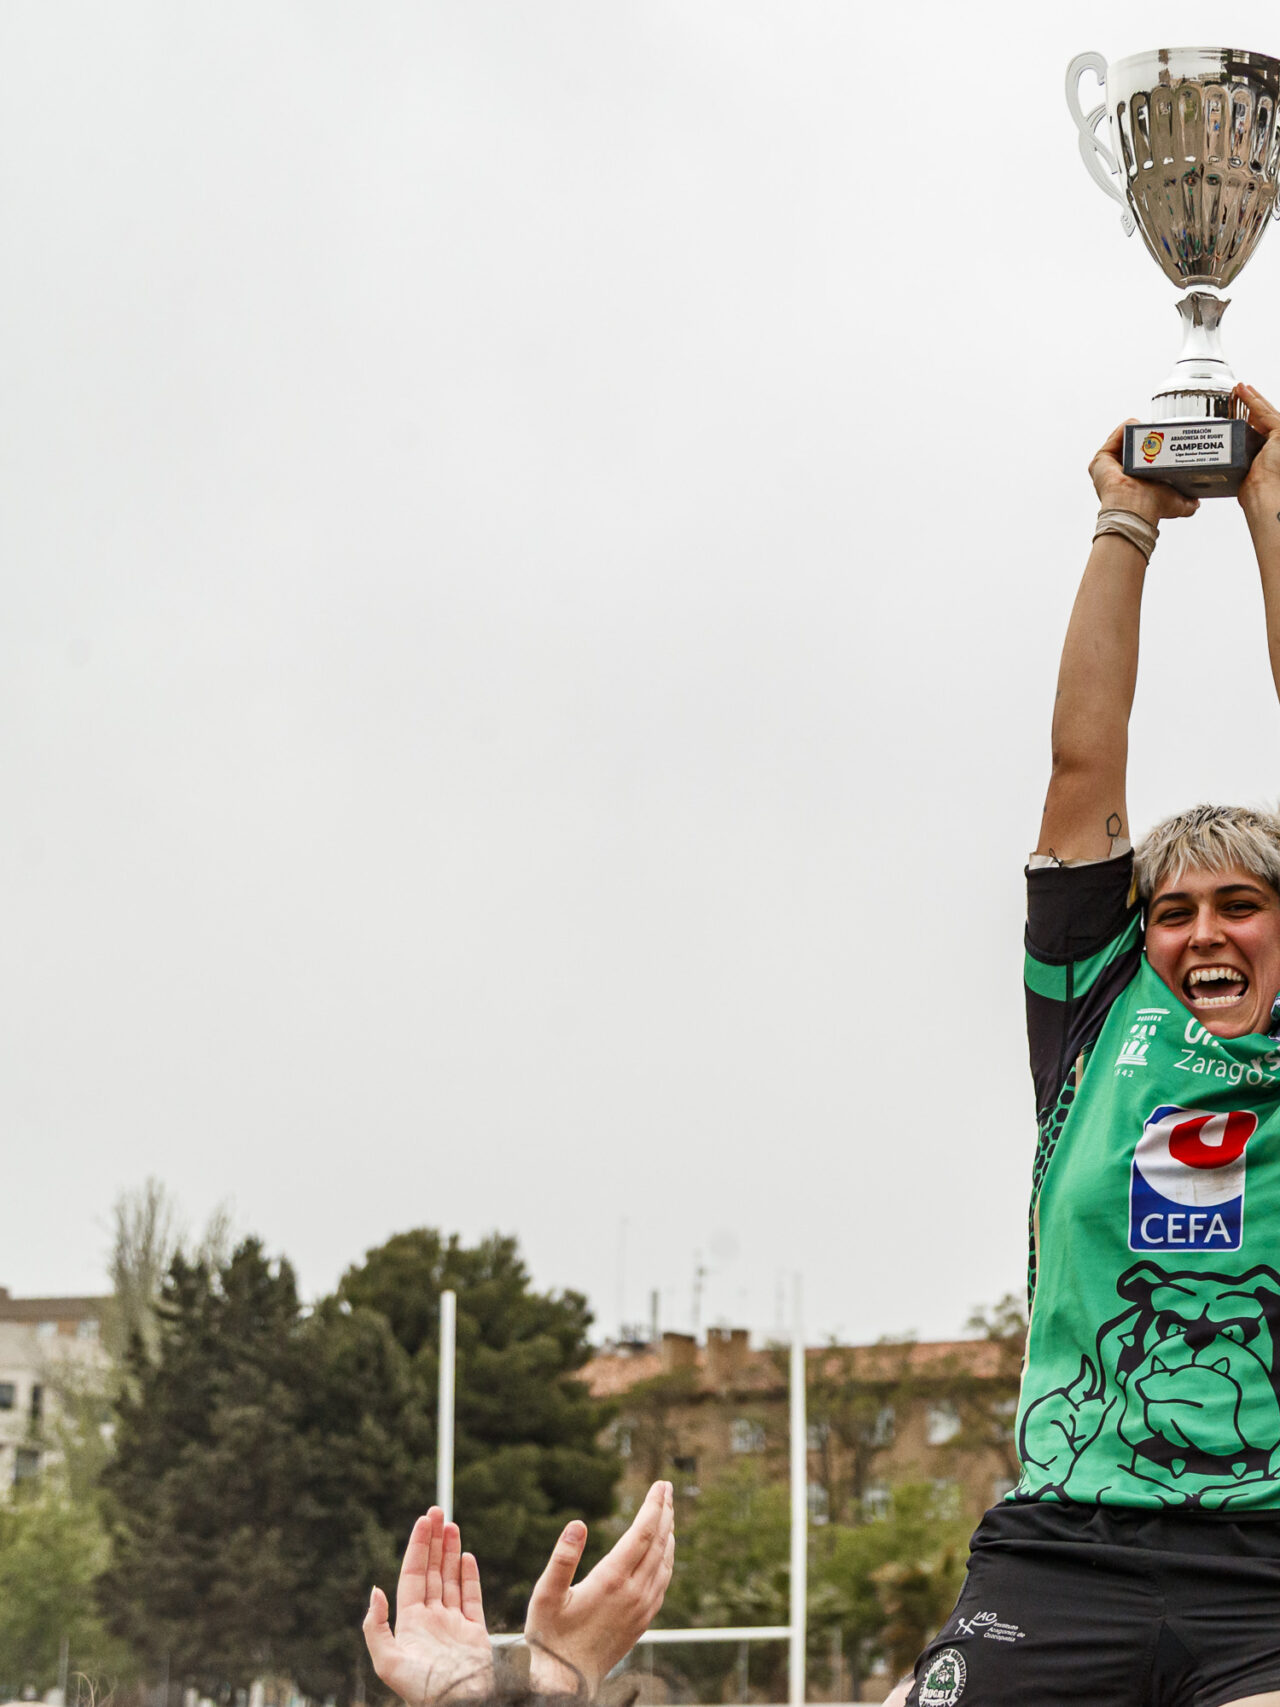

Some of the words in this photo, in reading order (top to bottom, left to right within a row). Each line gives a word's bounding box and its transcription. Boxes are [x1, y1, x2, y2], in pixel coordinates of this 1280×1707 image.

[1170, 441, 1224, 451] CAMPEONA
[1140, 1213, 1232, 1244] CEFA
[973, 1611, 998, 1621] IAO
